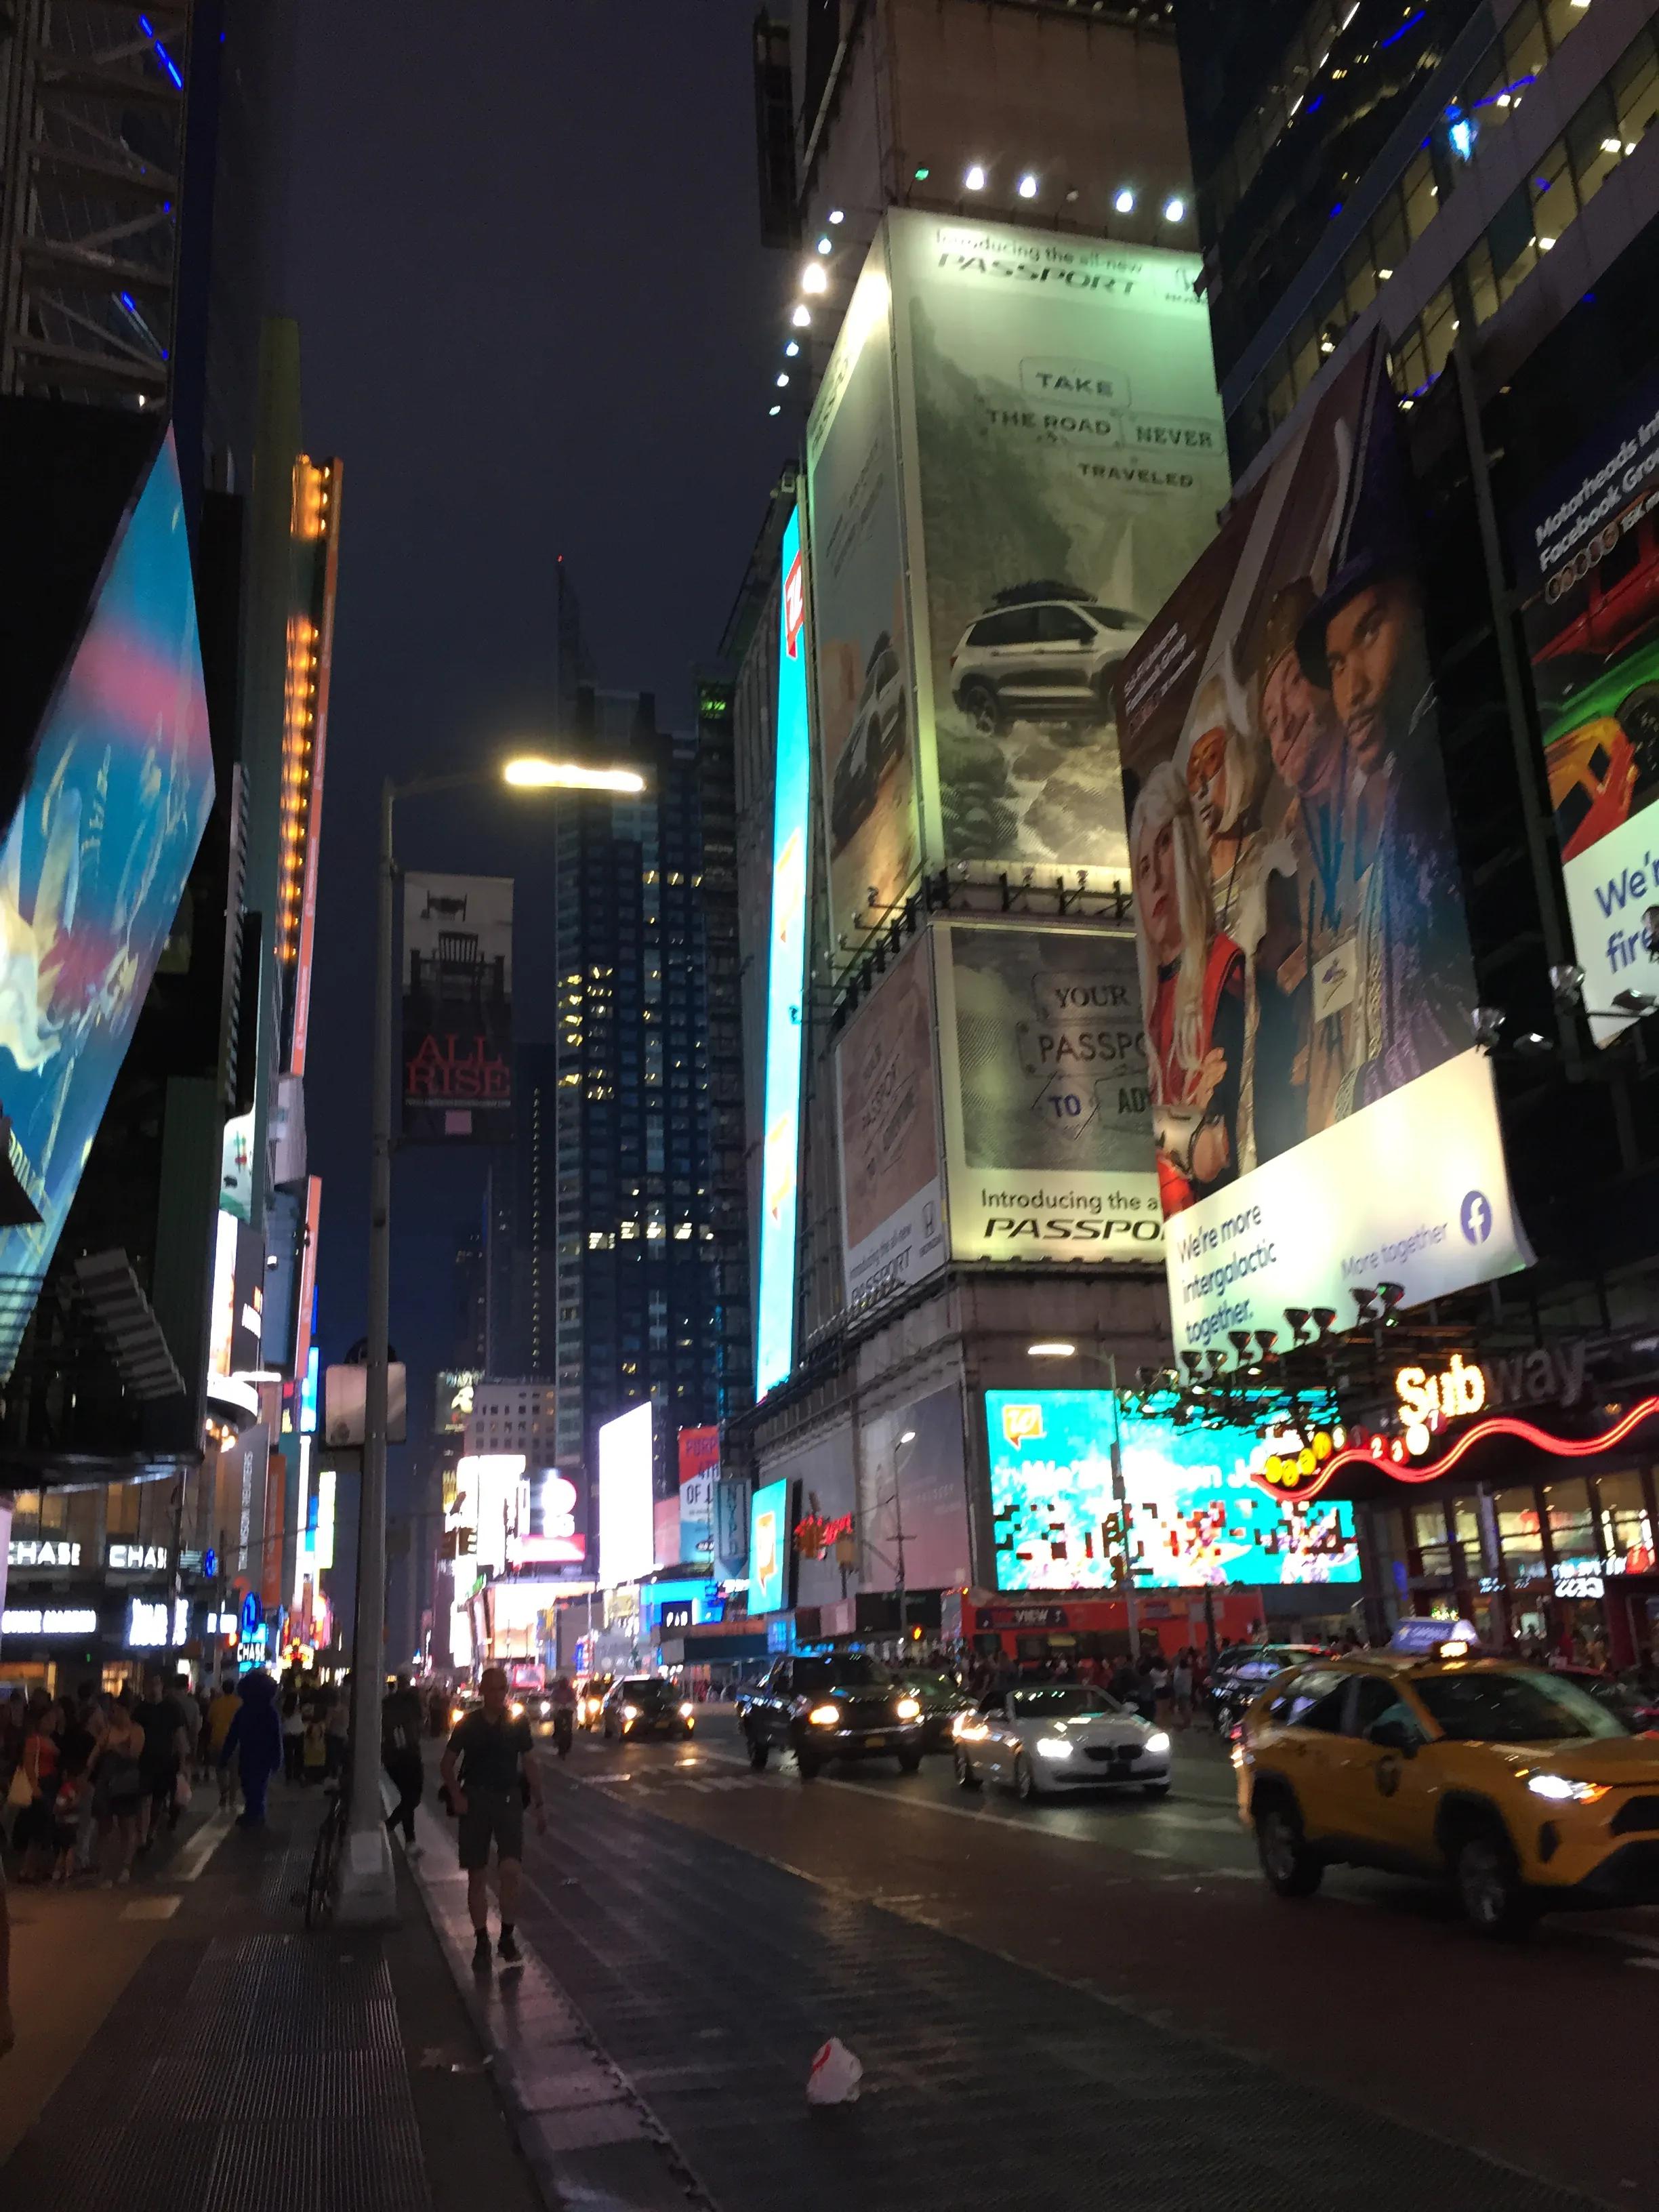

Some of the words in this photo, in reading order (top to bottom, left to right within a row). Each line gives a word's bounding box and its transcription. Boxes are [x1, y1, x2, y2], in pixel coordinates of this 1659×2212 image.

[937, 252, 1137, 296] PASSPORT
[1035, 371, 1114, 398] TAKE
[986, 408, 1036, 429] THE
[1043, 415, 1112, 436] ROAD
[1135, 426, 1213, 448] NEVER
[1078, 463, 1194, 488] TRAVELED
[1535, 438, 1639, 547] Motorheads
[1540, 484, 1622, 573] Facebook
[1054, 985, 1130, 1009] YOUR
[415, 1033, 503, 1066] ALL
[408, 1063, 510, 1097] RISE
[1048, 1094, 1082, 1118] TO
[981, 1187, 1103, 1214] Introducing
[1107, 1190, 1143, 1211] the
[983, 1217, 1166, 1242] PASSPO
[1177, 1225, 1218, 1264] We're
[1220, 1204, 1262, 1244] more
[1340, 1251, 1379, 1281] More
[1380, 1223, 1448, 1265] together
[1181, 1238, 1277, 1305] intergalactic
[1185, 1298, 1254, 1347] together.
[237, 1642, 266, 1662] CHASE
